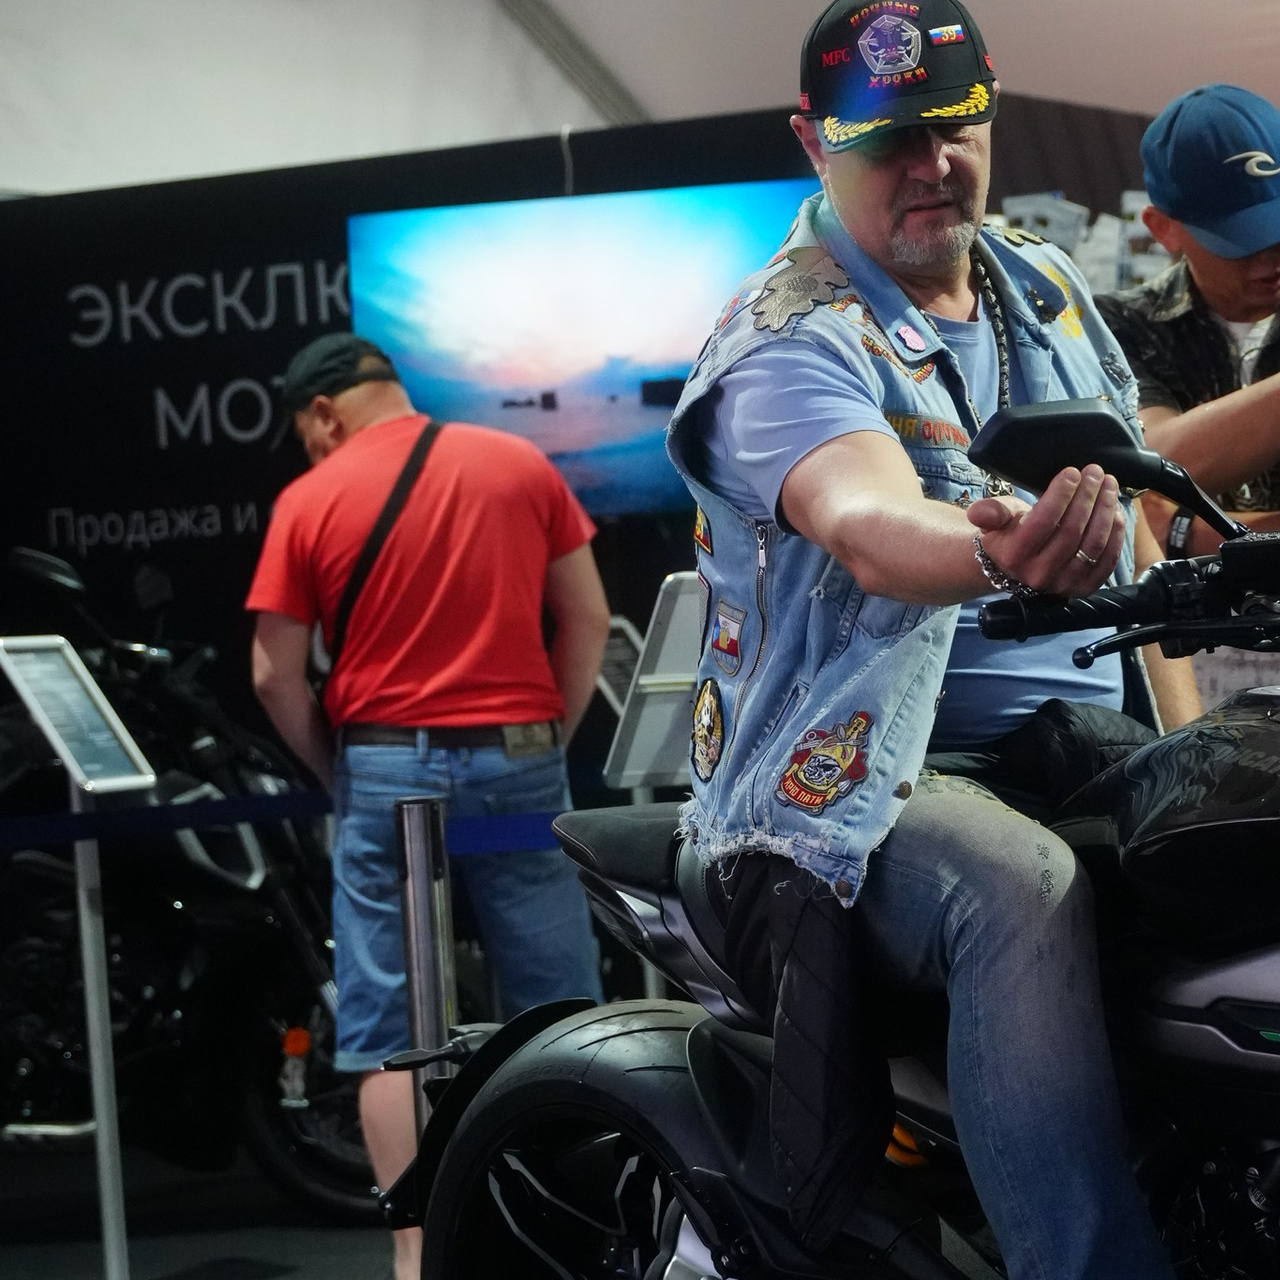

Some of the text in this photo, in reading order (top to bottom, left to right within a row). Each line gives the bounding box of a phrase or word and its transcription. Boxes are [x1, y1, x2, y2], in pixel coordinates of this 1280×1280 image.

[939, 27, 957, 41] 39
[821, 47, 851, 68] MFC
[153, 377, 286, 451] МО
[50, 507, 223, 558] Продажа
[796, 790, 824, 805] ПАТИ
